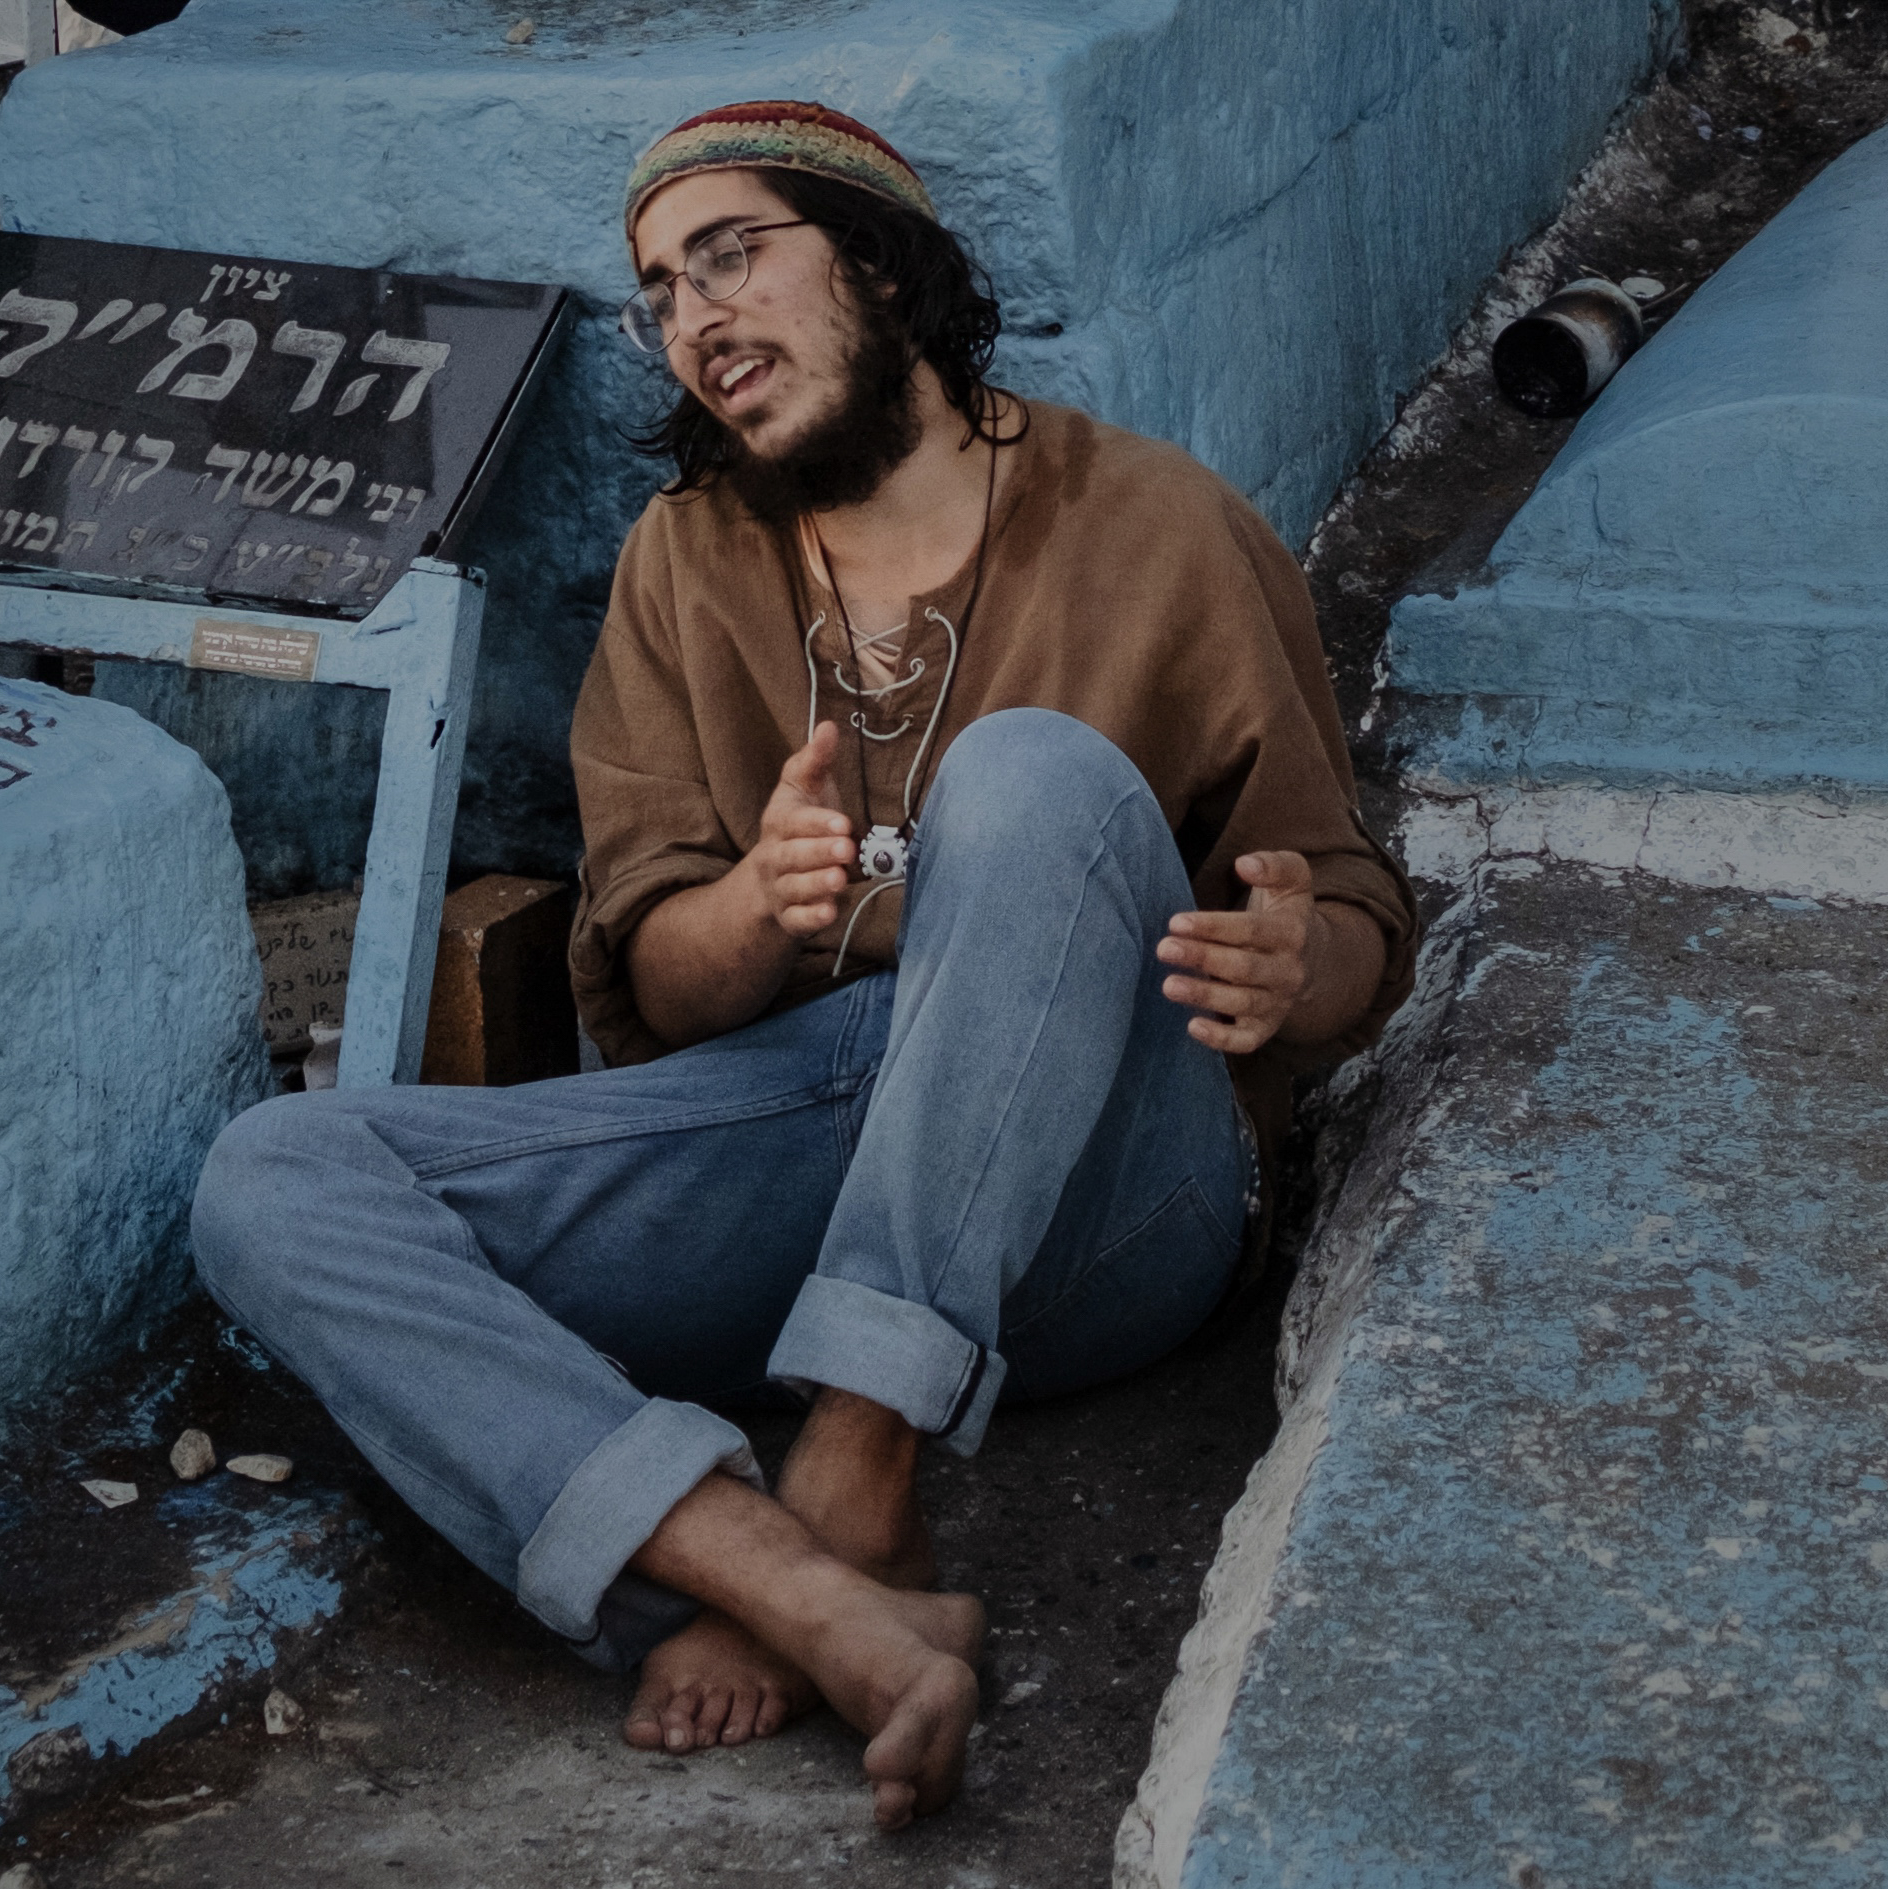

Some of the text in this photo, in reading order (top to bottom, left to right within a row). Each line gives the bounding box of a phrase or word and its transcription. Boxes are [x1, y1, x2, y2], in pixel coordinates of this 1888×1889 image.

[199, 264, 293, 304] ציון
[194, 443, 355, 515] משה
[365, 482, 424, 524] רבי
